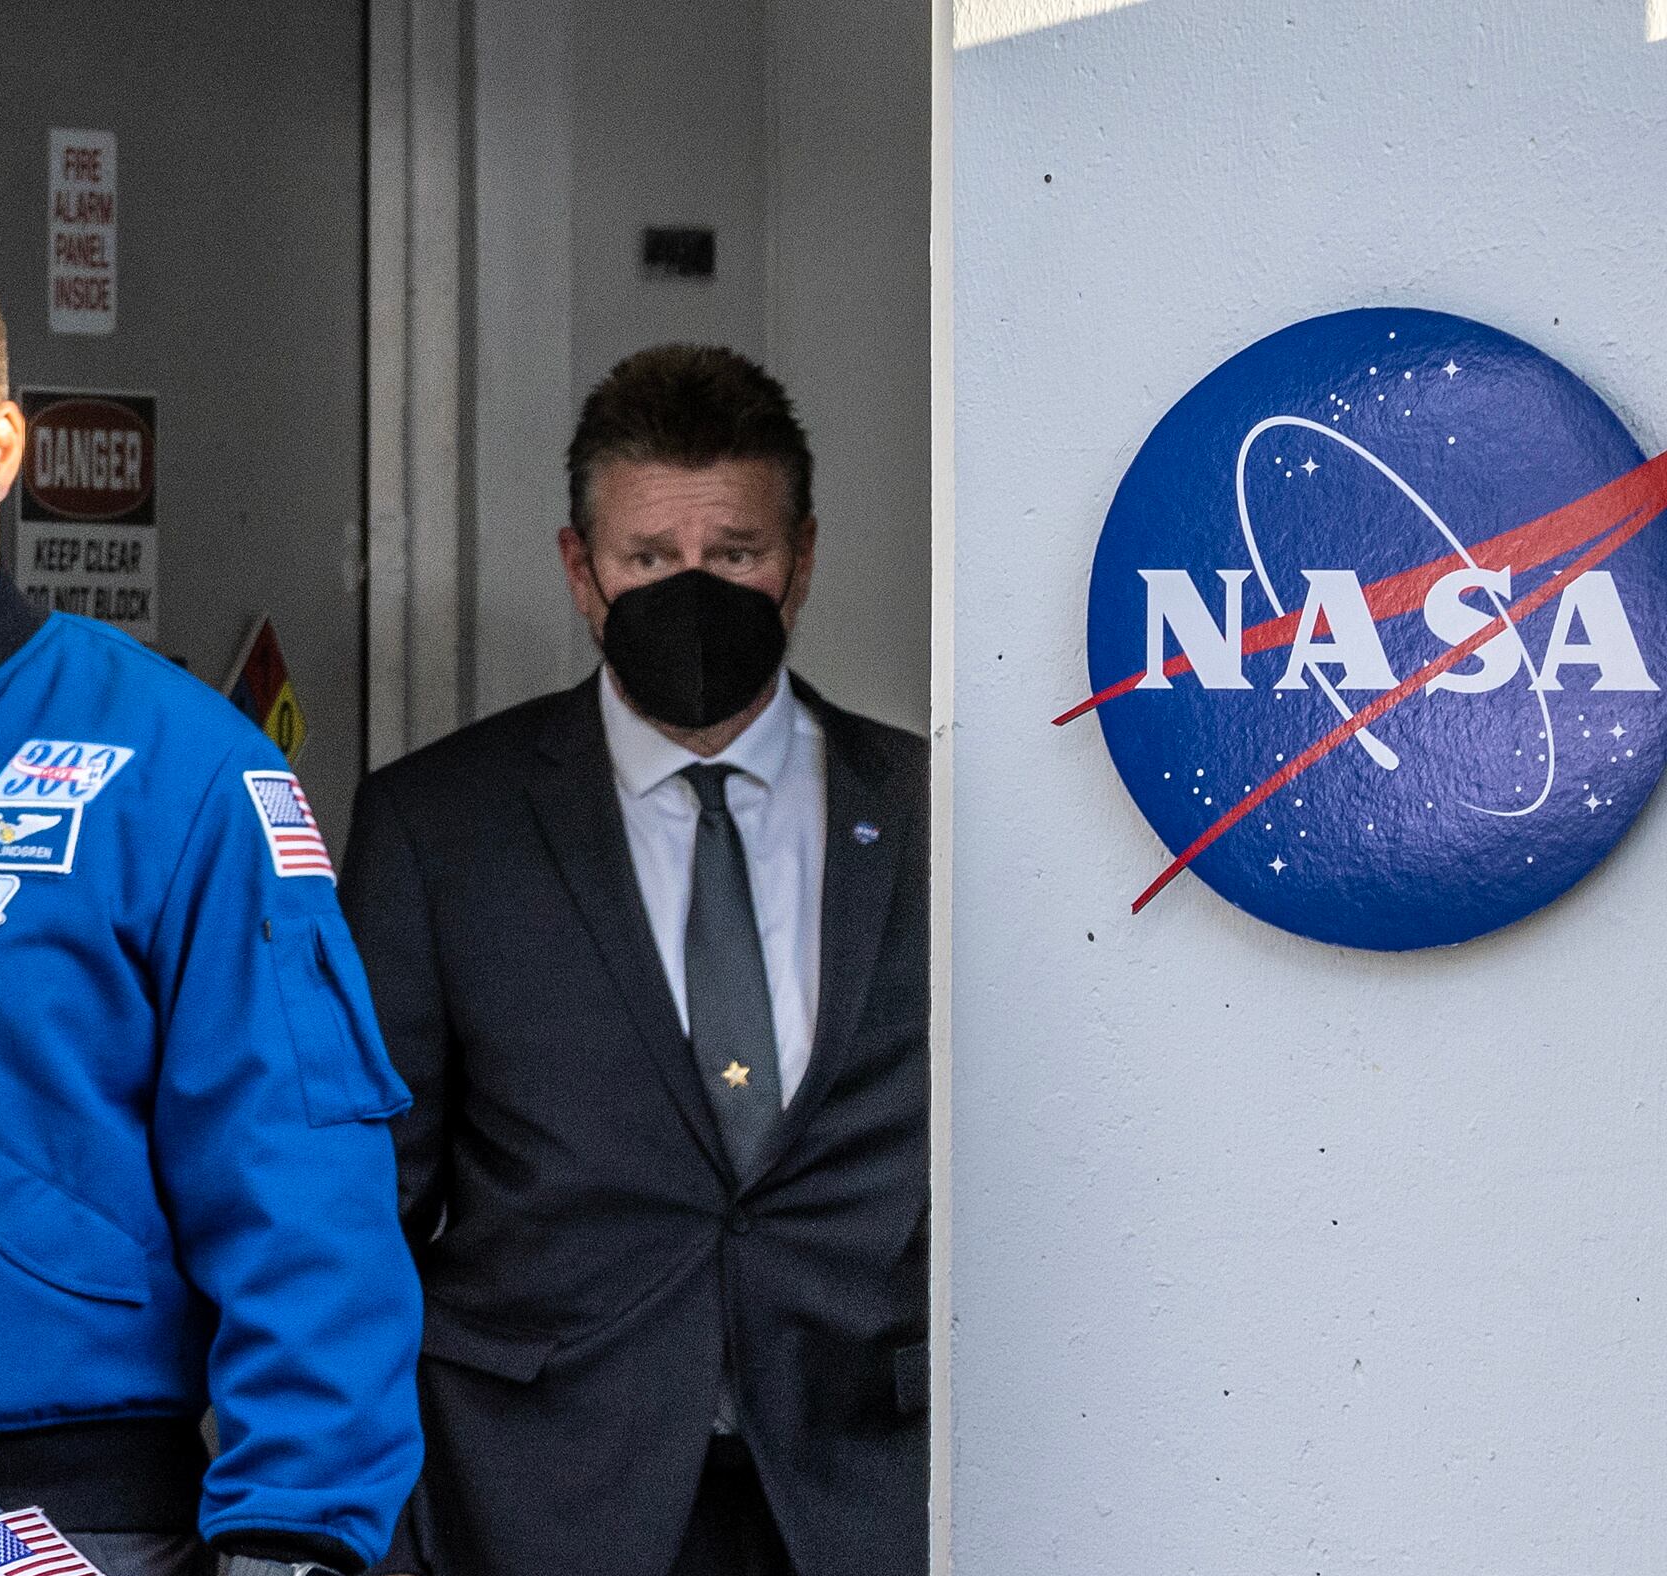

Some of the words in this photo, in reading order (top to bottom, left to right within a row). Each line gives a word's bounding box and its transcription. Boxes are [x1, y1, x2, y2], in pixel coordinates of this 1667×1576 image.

[64, 148, 101, 184] FIRE
[54, 190, 113, 225] ALARM
[54, 233, 109, 268] PANEL
[54, 276, 110, 311] INSIDE
[34, 425, 143, 491] DANGER
[34, 536, 81, 573] KEEP
[85, 537, 142, 574] CLEAR
[94, 586, 150, 621] BLOCK
[1135, 565, 1661, 697] NASA
